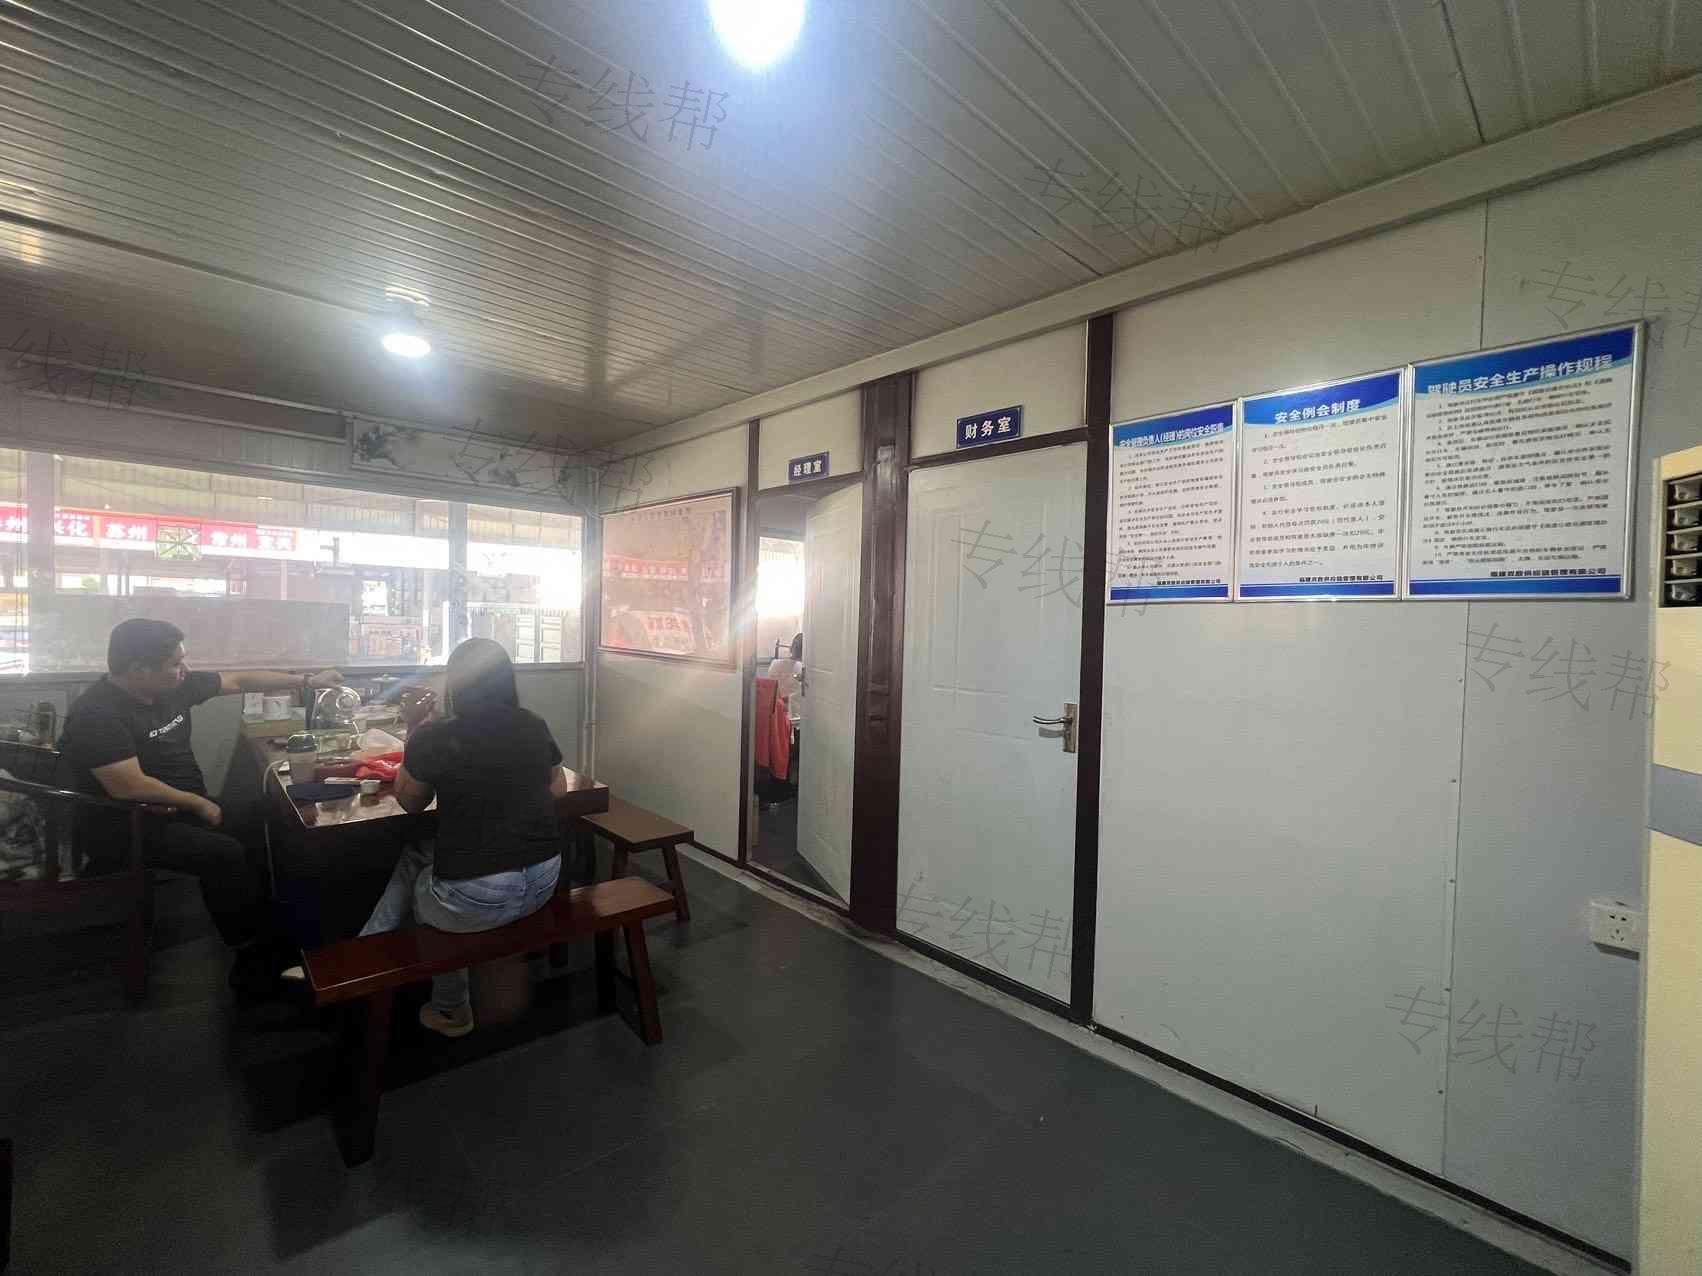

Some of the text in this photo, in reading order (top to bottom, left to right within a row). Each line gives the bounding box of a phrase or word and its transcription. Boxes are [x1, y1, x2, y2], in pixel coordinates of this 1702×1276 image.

[1275, 399, 1361, 424] 安全例会制度
[965, 416, 1012, 440] 财务室
[793, 460, 822, 477] 经理室
